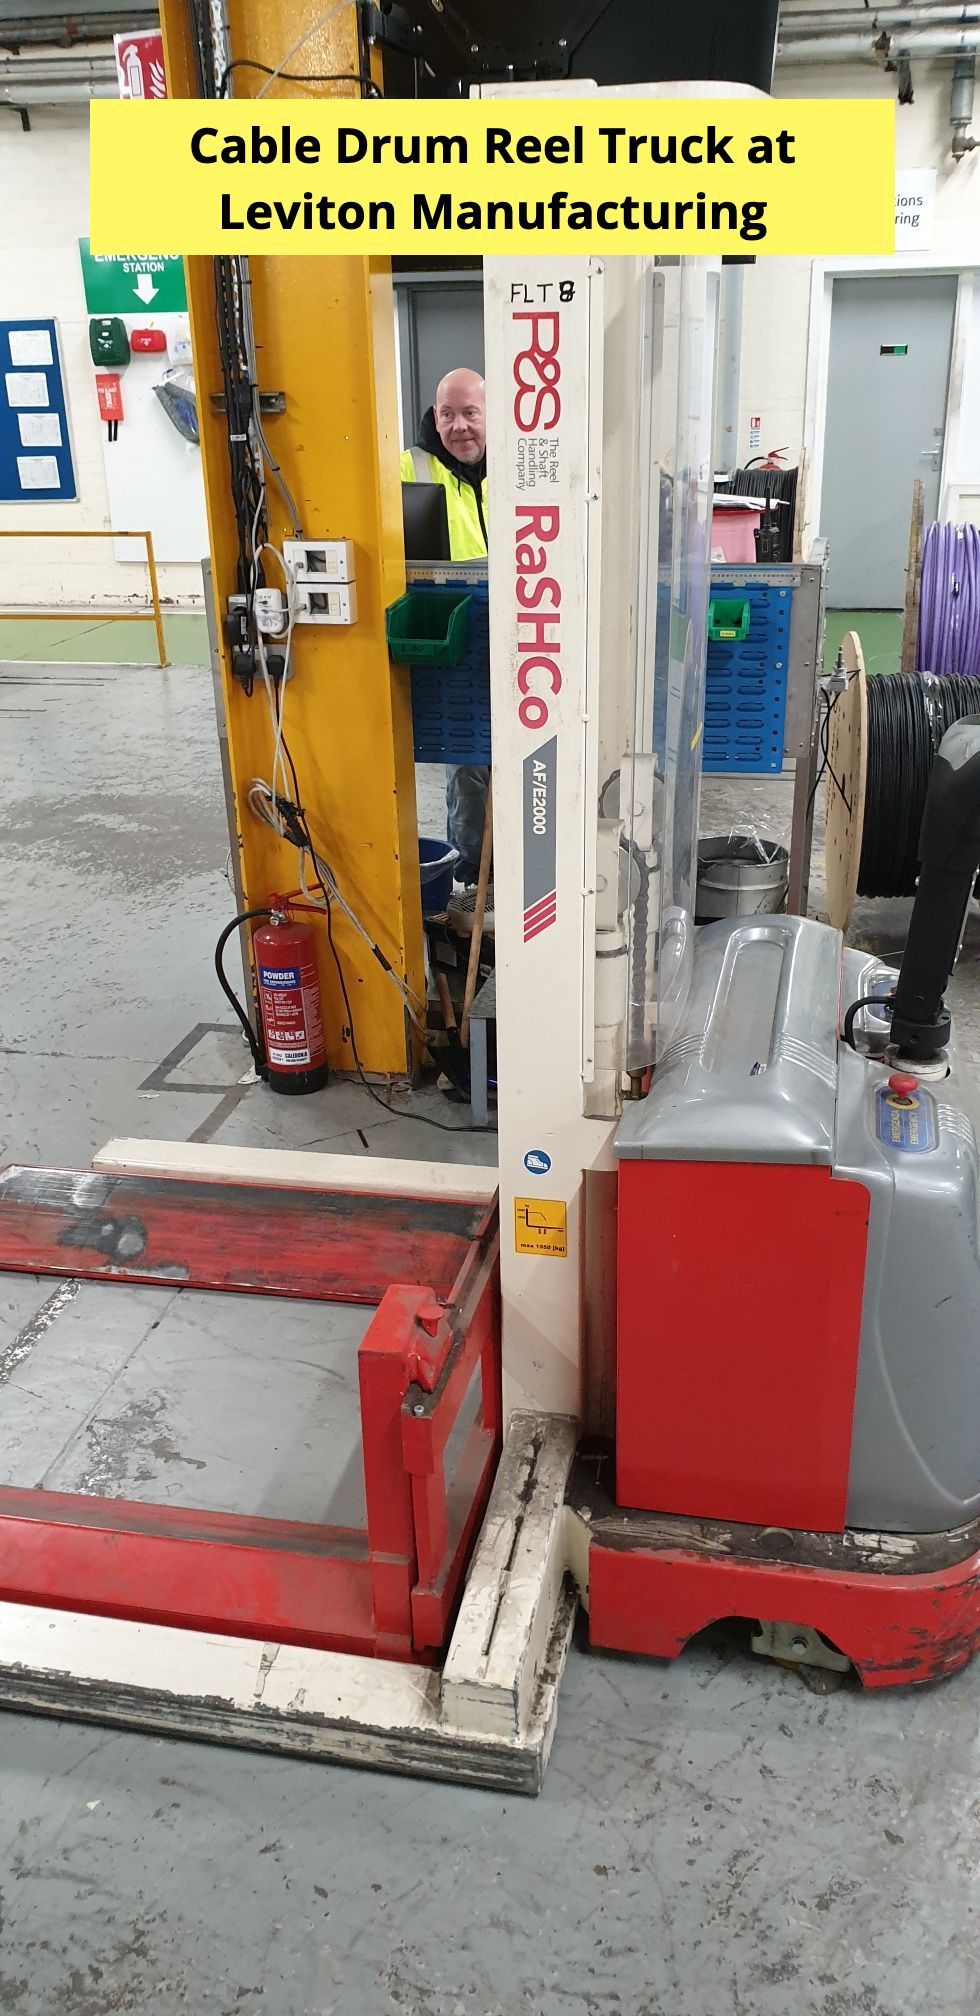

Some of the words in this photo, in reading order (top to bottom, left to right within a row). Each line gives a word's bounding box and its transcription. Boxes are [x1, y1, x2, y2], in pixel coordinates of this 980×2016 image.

[894, 194, 923, 207] ions
[122, 261, 165, 273] STATION
[510, 283, 553, 304] FLT
[538, 437, 549, 447] &
[549, 437, 560, 458] The
[515, 437, 528, 491] Company
[526, 437, 539, 487] Handling
[538, 450, 549, 478] Shaft
[549, 461, 560, 483] Reel
[514, 505, 562, 730] RaSHCo
[532, 759, 547, 835] AF/E2000
[263, 970, 295, 980] POWDER
